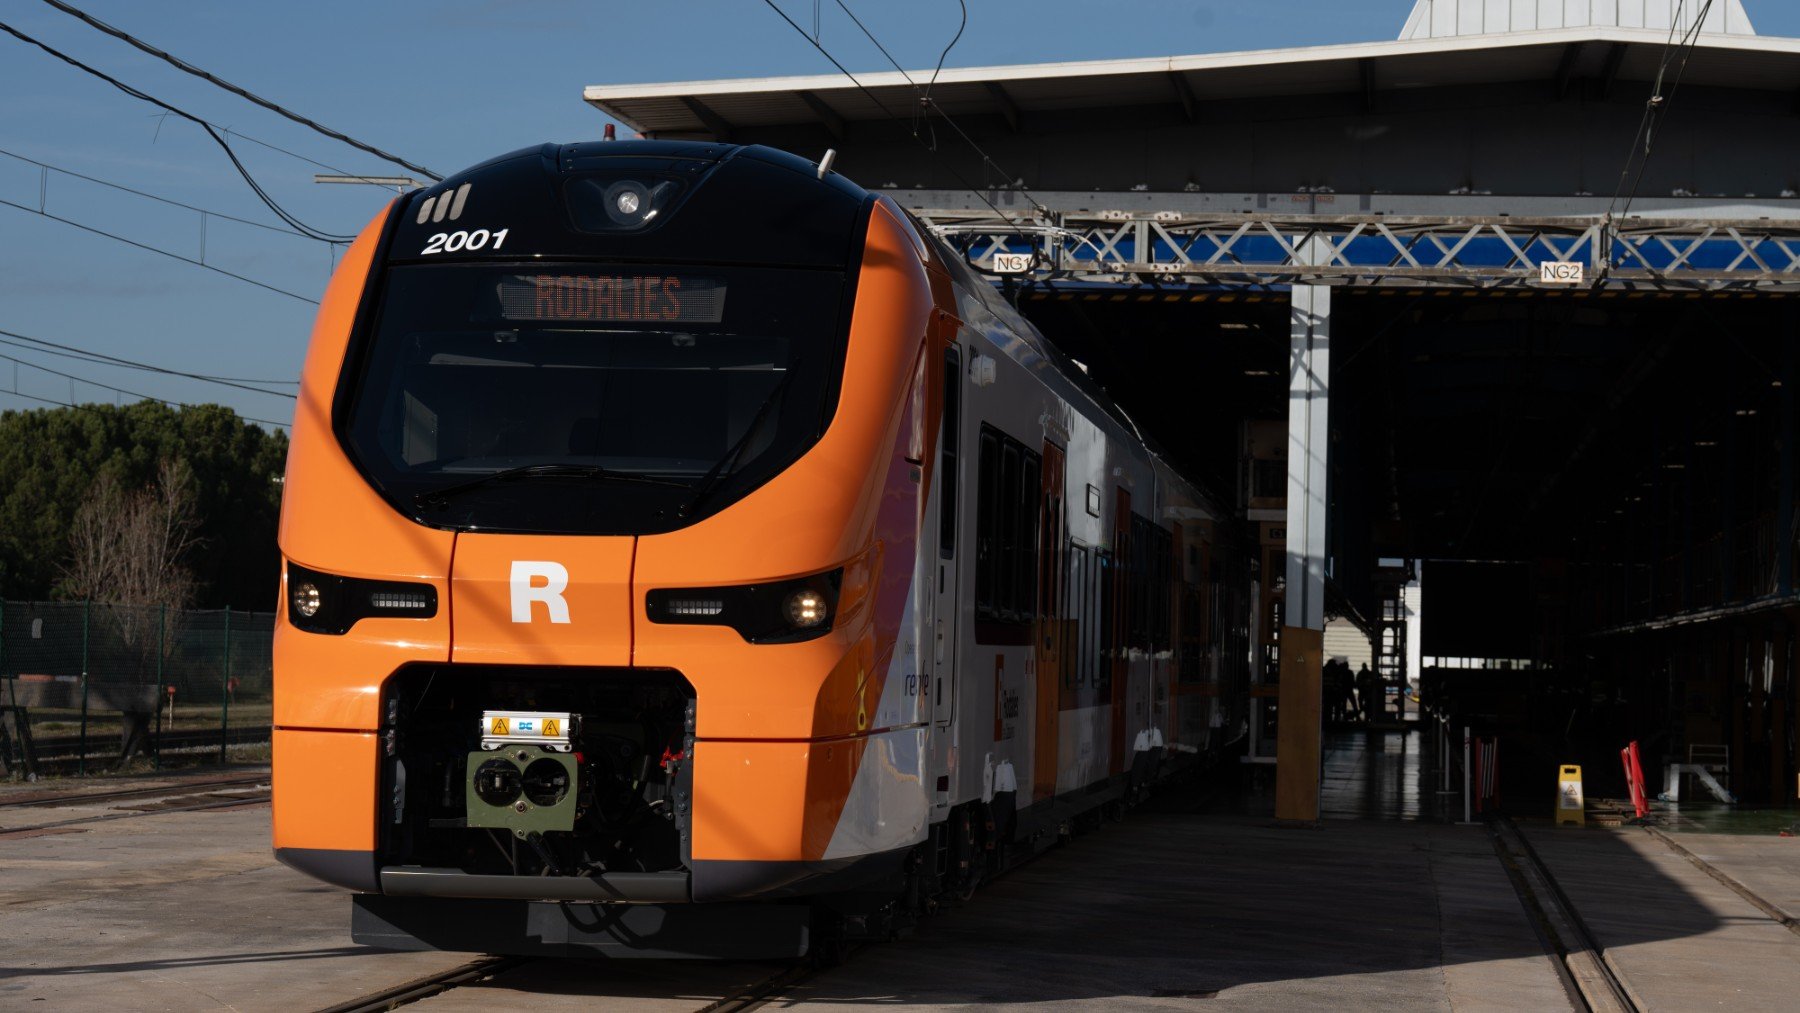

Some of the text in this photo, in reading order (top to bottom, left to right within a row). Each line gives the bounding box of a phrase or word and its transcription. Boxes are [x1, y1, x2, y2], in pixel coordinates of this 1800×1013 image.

[420, 228, 509, 255] 2001
[997, 256, 1029, 271] NG1
[1543, 264, 1580, 279] NG2
[535, 274, 681, 320] RODALIES
[510, 560, 572, 624] R
